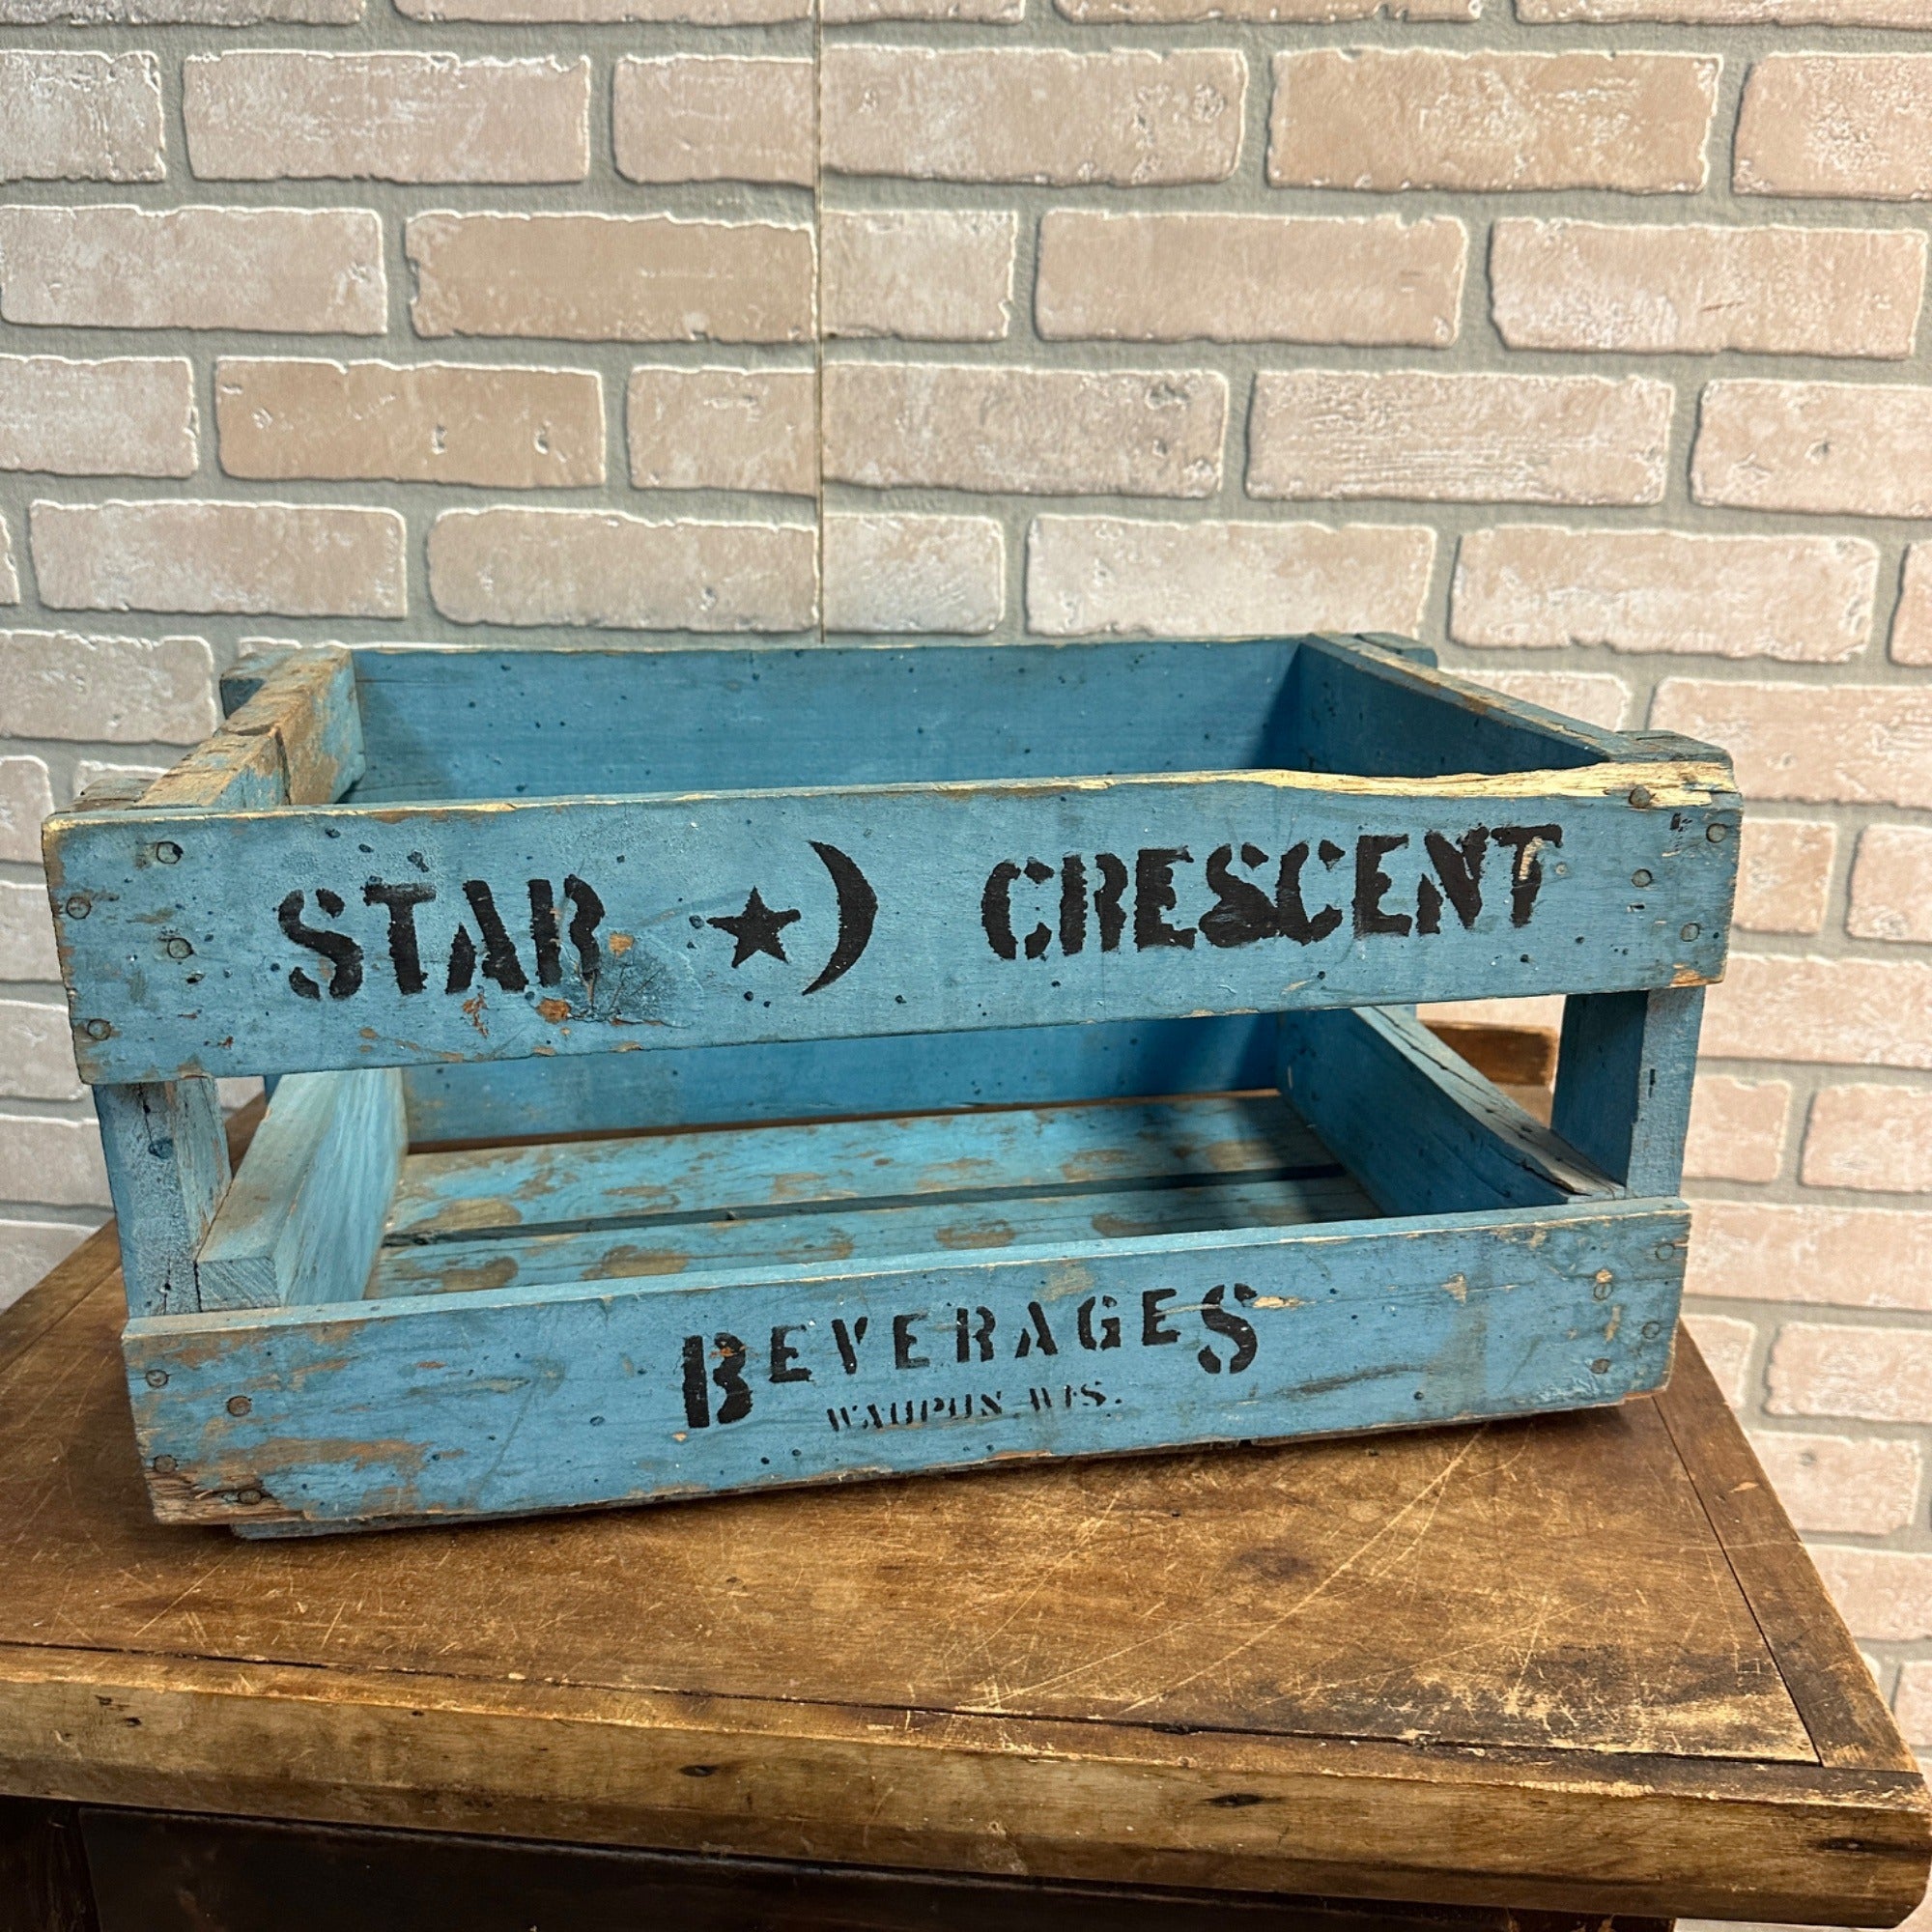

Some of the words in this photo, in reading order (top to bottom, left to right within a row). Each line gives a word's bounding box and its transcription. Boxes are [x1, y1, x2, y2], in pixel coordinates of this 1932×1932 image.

[276, 874, 607, 1001] STAR
[980, 824, 1563, 960] CRESCENT
[683, 1284, 1258, 1429] BEVERAGES
